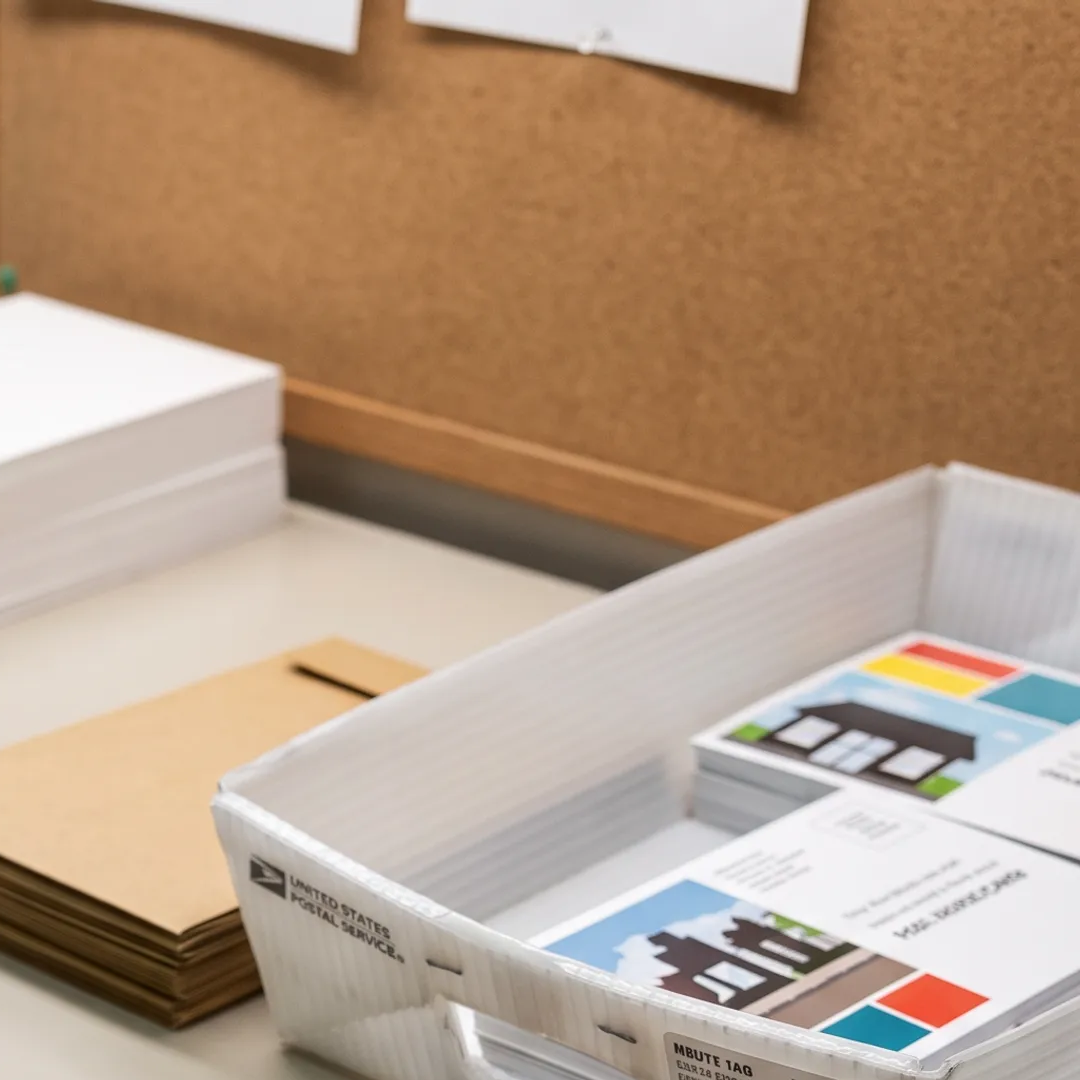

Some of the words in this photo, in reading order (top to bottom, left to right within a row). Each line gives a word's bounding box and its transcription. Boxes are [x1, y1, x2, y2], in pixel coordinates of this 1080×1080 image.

[290, 875, 339, 909] UNITED
[340, 903, 391, 940] STATES
[290, 892, 339, 928] POSTAL
